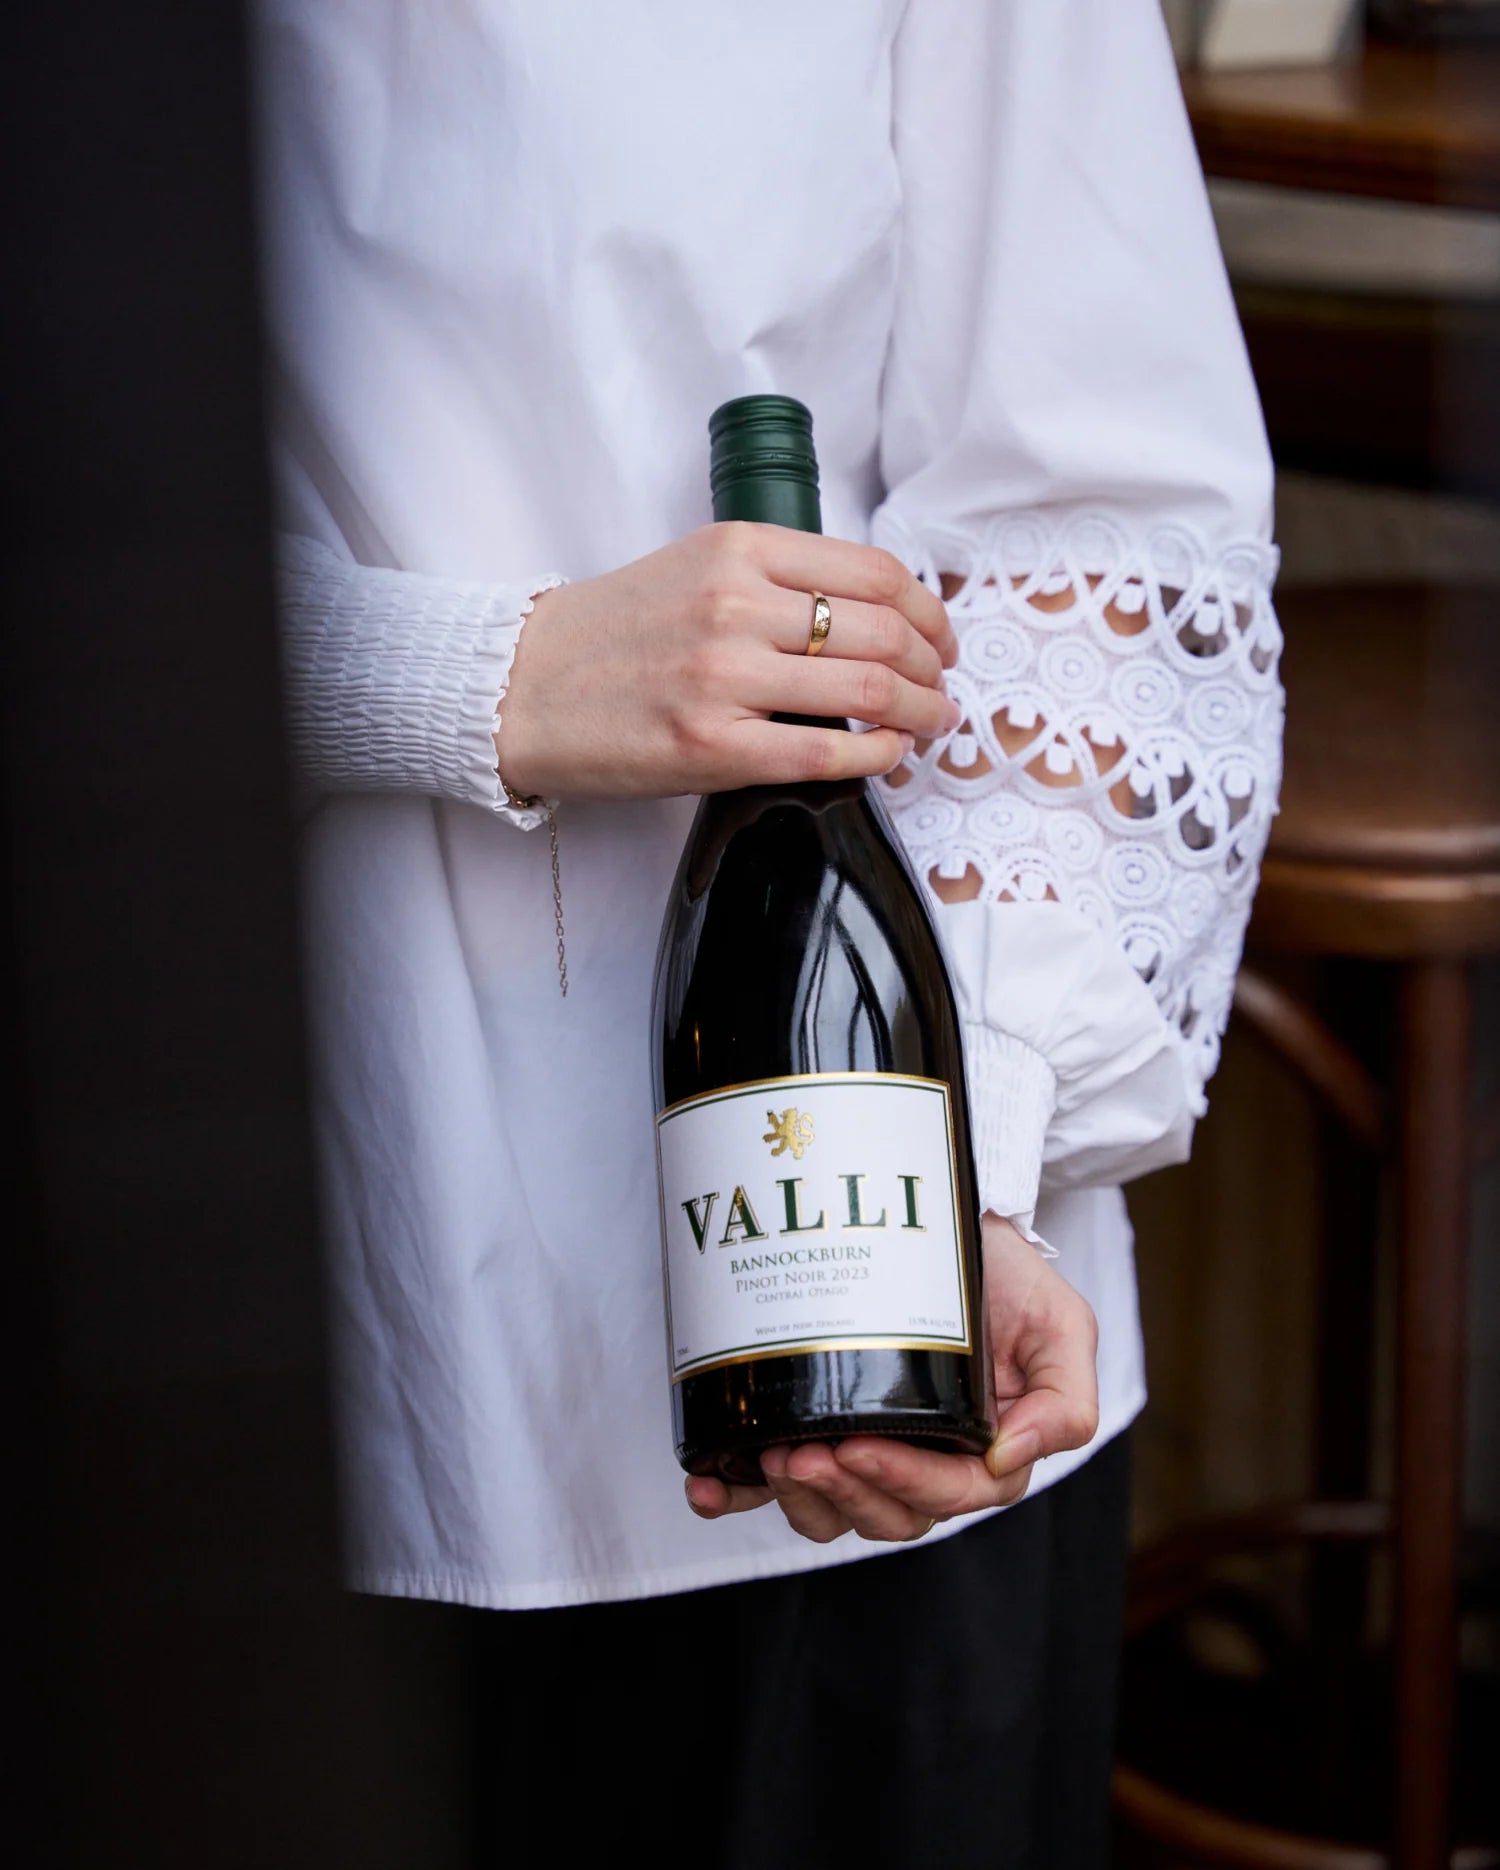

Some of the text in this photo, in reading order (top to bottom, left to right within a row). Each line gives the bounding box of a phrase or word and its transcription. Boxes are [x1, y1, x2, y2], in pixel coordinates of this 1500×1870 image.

[681, 1173, 927, 1255] VALLI
[730, 1246, 872, 1274] BANNOCKBURN
[735, 1266, 870, 1293] PINOT NOIR 2023
[755, 1286, 849, 1305] CENTRAL OTAGO
